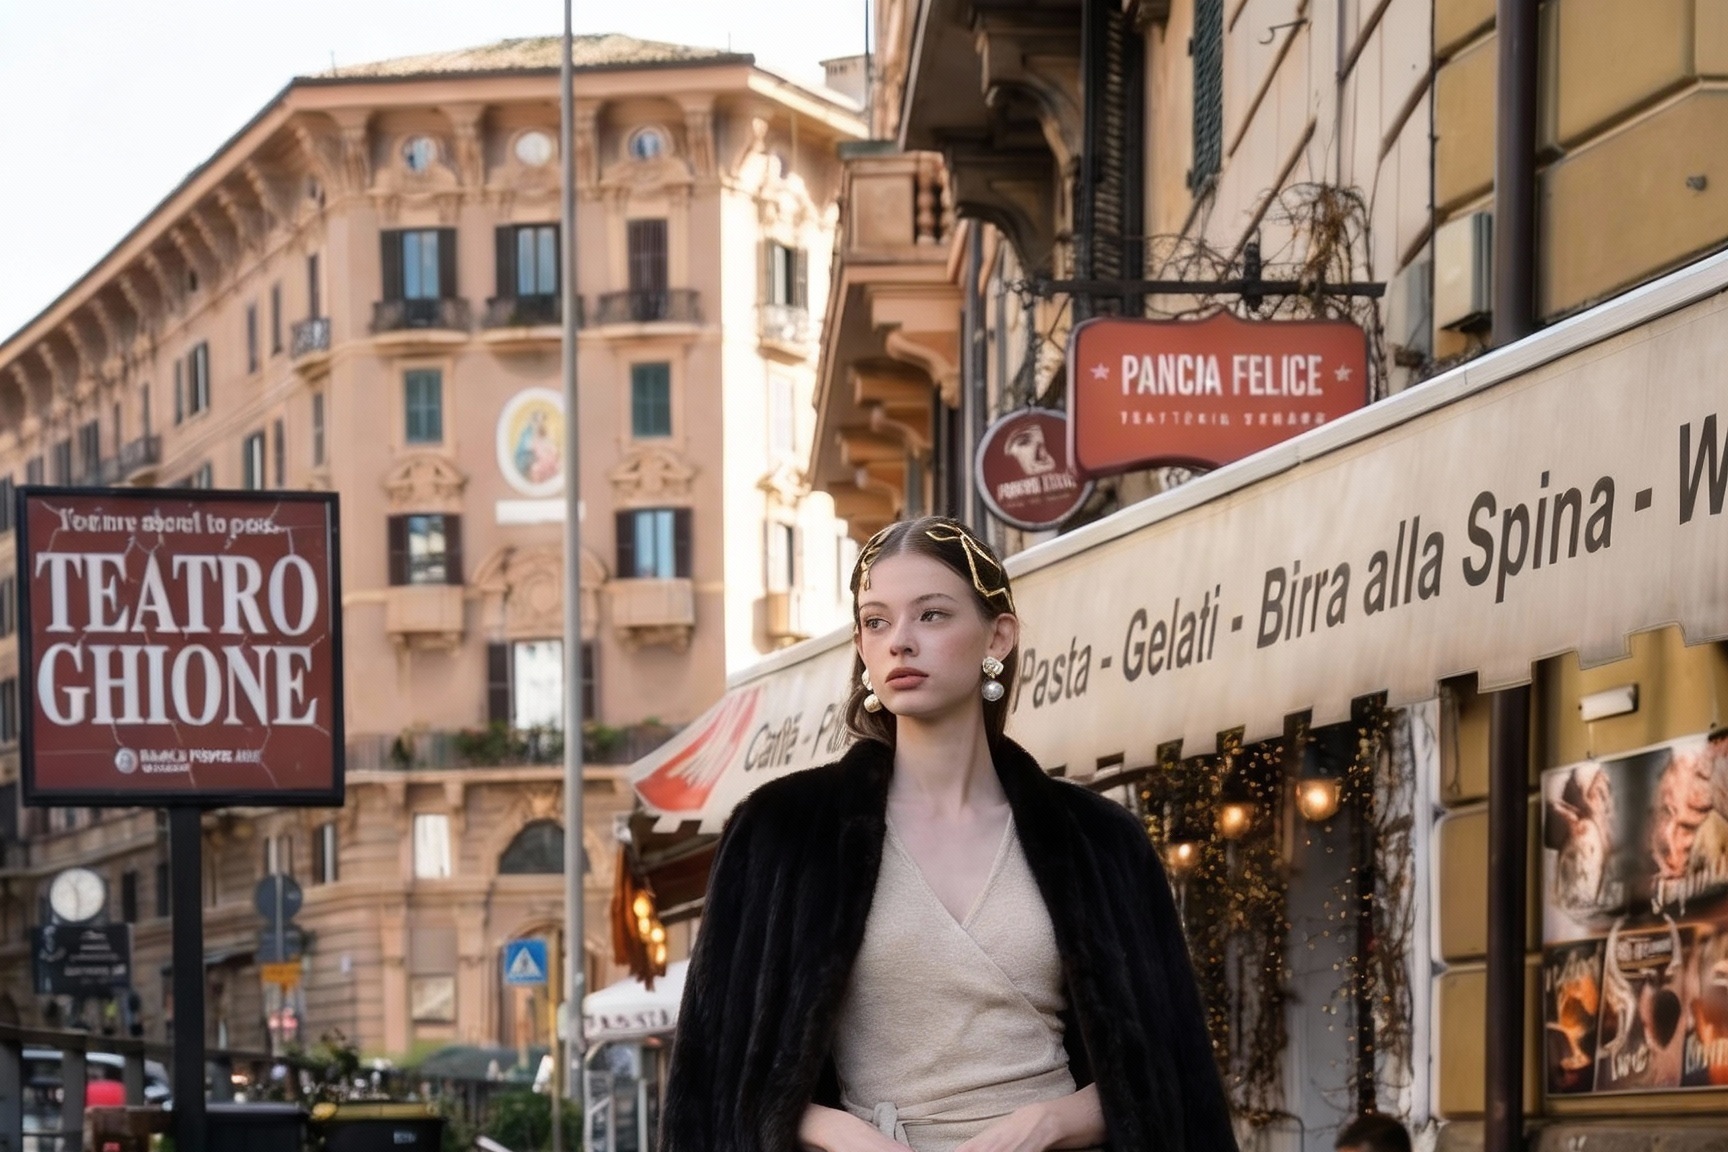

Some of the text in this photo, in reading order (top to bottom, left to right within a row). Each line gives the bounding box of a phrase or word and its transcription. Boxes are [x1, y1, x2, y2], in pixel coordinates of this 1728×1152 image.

[1121, 353, 1324, 396] PANCIA FELICE
[35, 552, 319, 637] TEATRO
[1012, 635, 1092, 715] Pasta
[1122, 583, 1221, 682] Gelati
[1256, 559, 1351, 649] Birra
[1363, 514, 1445, 617] alla
[1461, 470, 1616, 604] Spina
[37, 643, 318, 726] GHIONE
